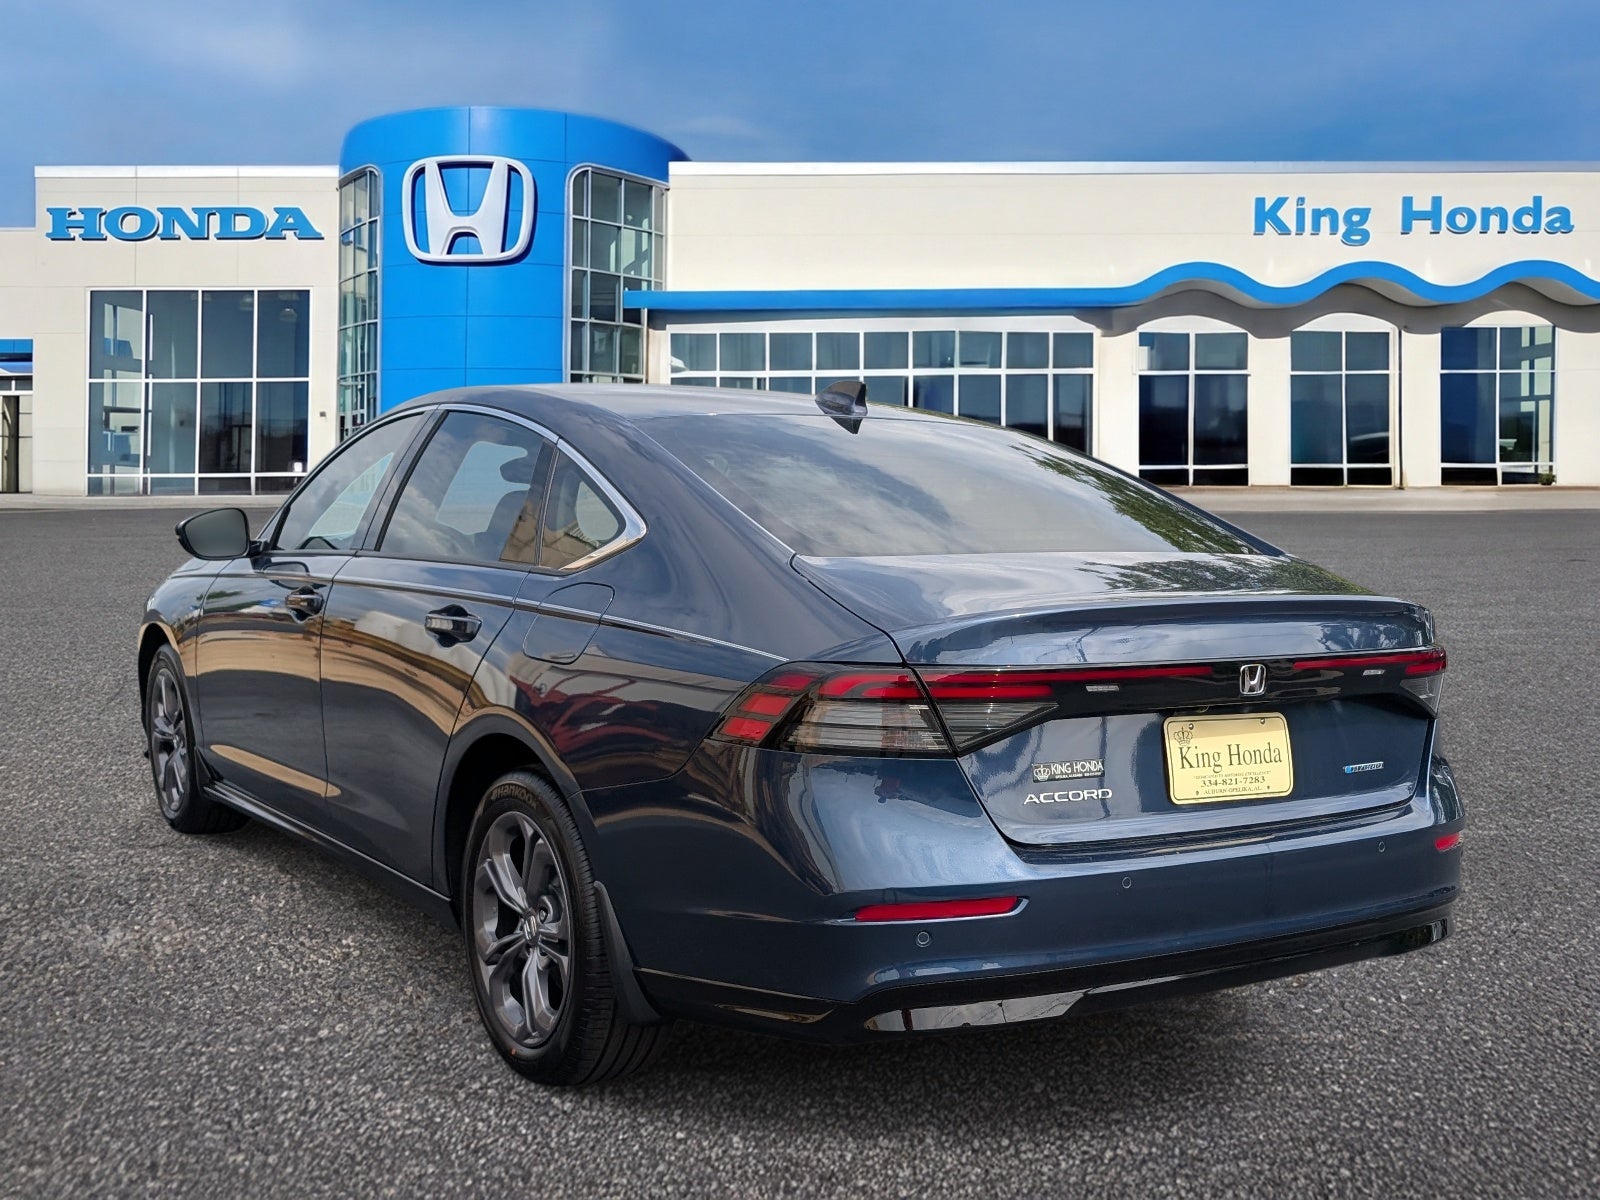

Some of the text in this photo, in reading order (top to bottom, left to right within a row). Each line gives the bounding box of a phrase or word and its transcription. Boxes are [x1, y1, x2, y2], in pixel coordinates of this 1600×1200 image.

[45, 206, 325, 241] HONDA
[1253, 195, 1575, 247] King Honda
[1050, 762, 1072, 775] KING
[1073, 760, 1104, 773] HONDA
[1178, 742, 1282, 774] King Honda
[1200, 776, 1266, 788] 334-821-7283
[1023, 788, 1113, 805] ACCORD
